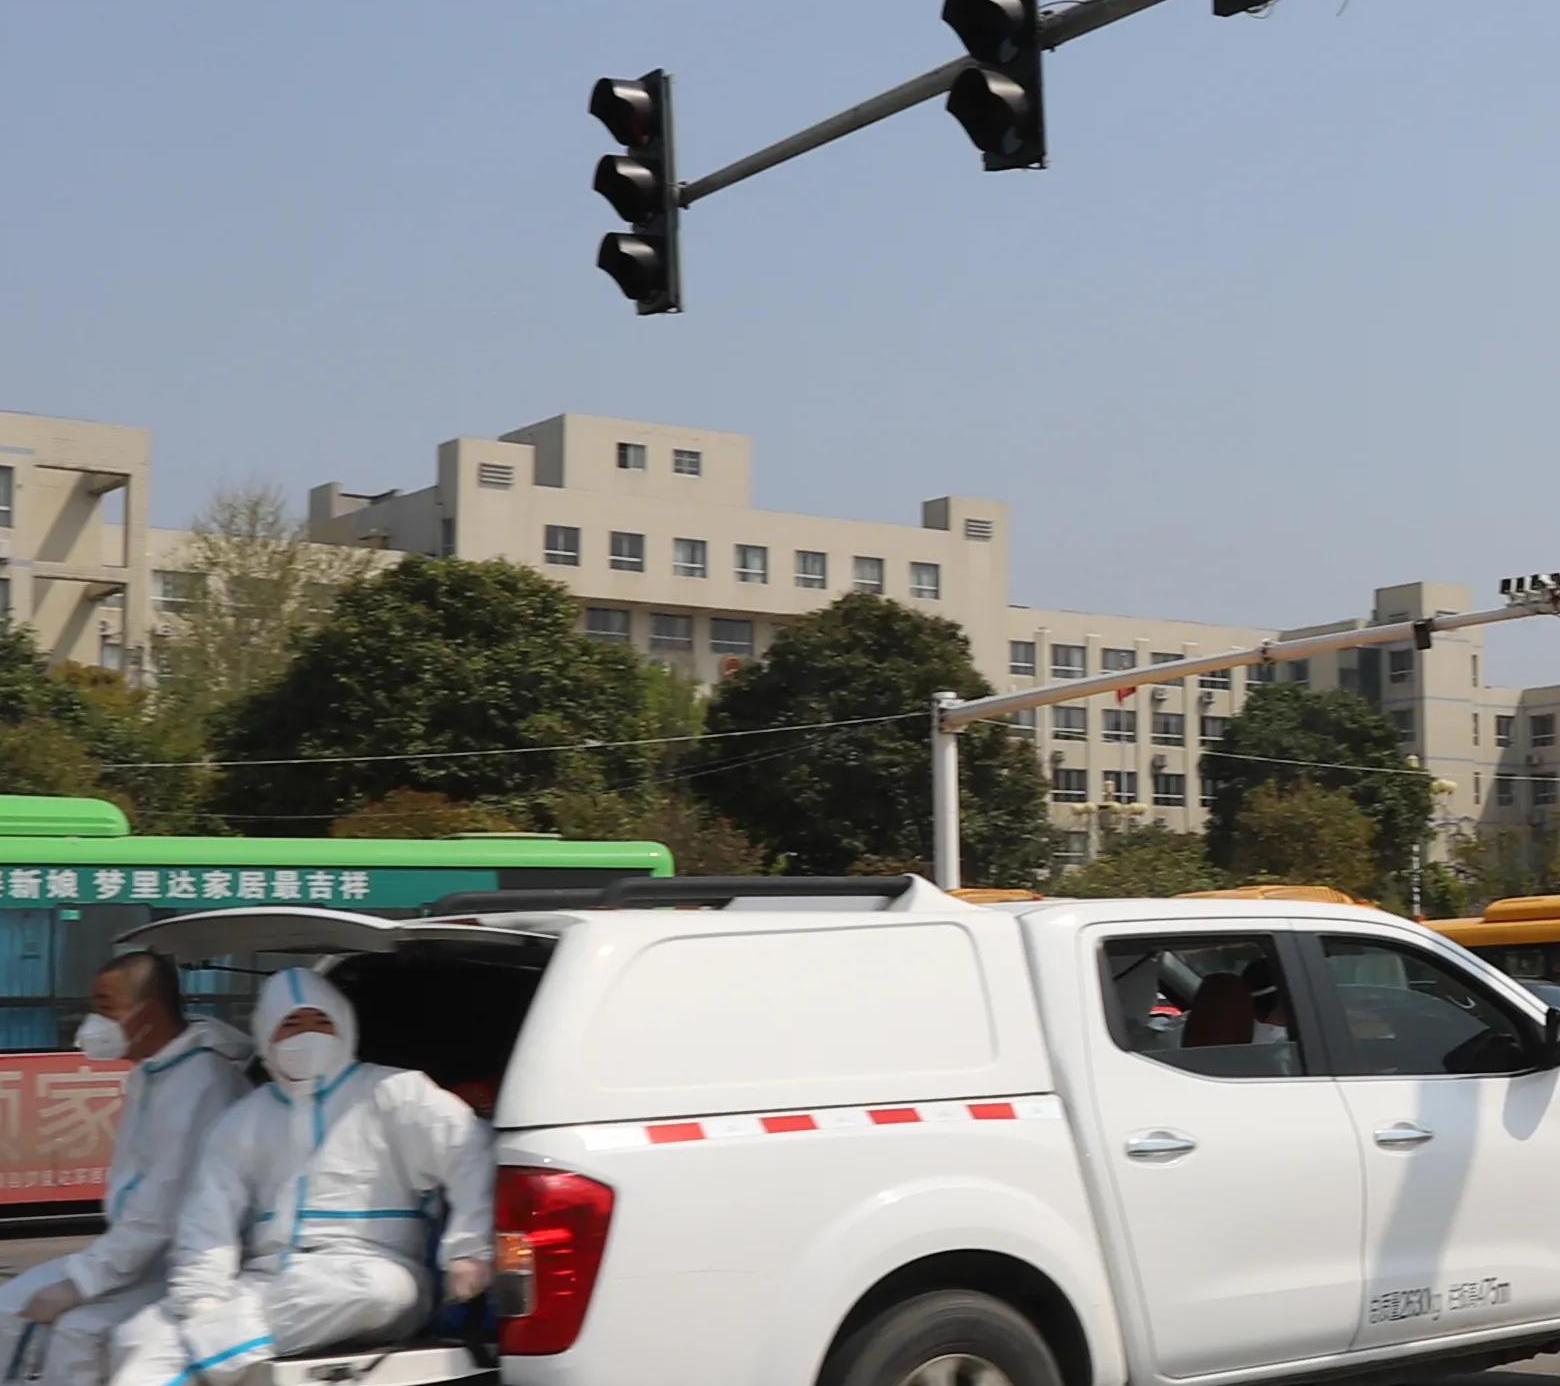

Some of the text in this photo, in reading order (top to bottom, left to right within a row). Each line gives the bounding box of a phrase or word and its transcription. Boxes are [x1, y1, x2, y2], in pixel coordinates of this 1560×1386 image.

[92, 869, 371, 901] 梦里达家居最吉祥
